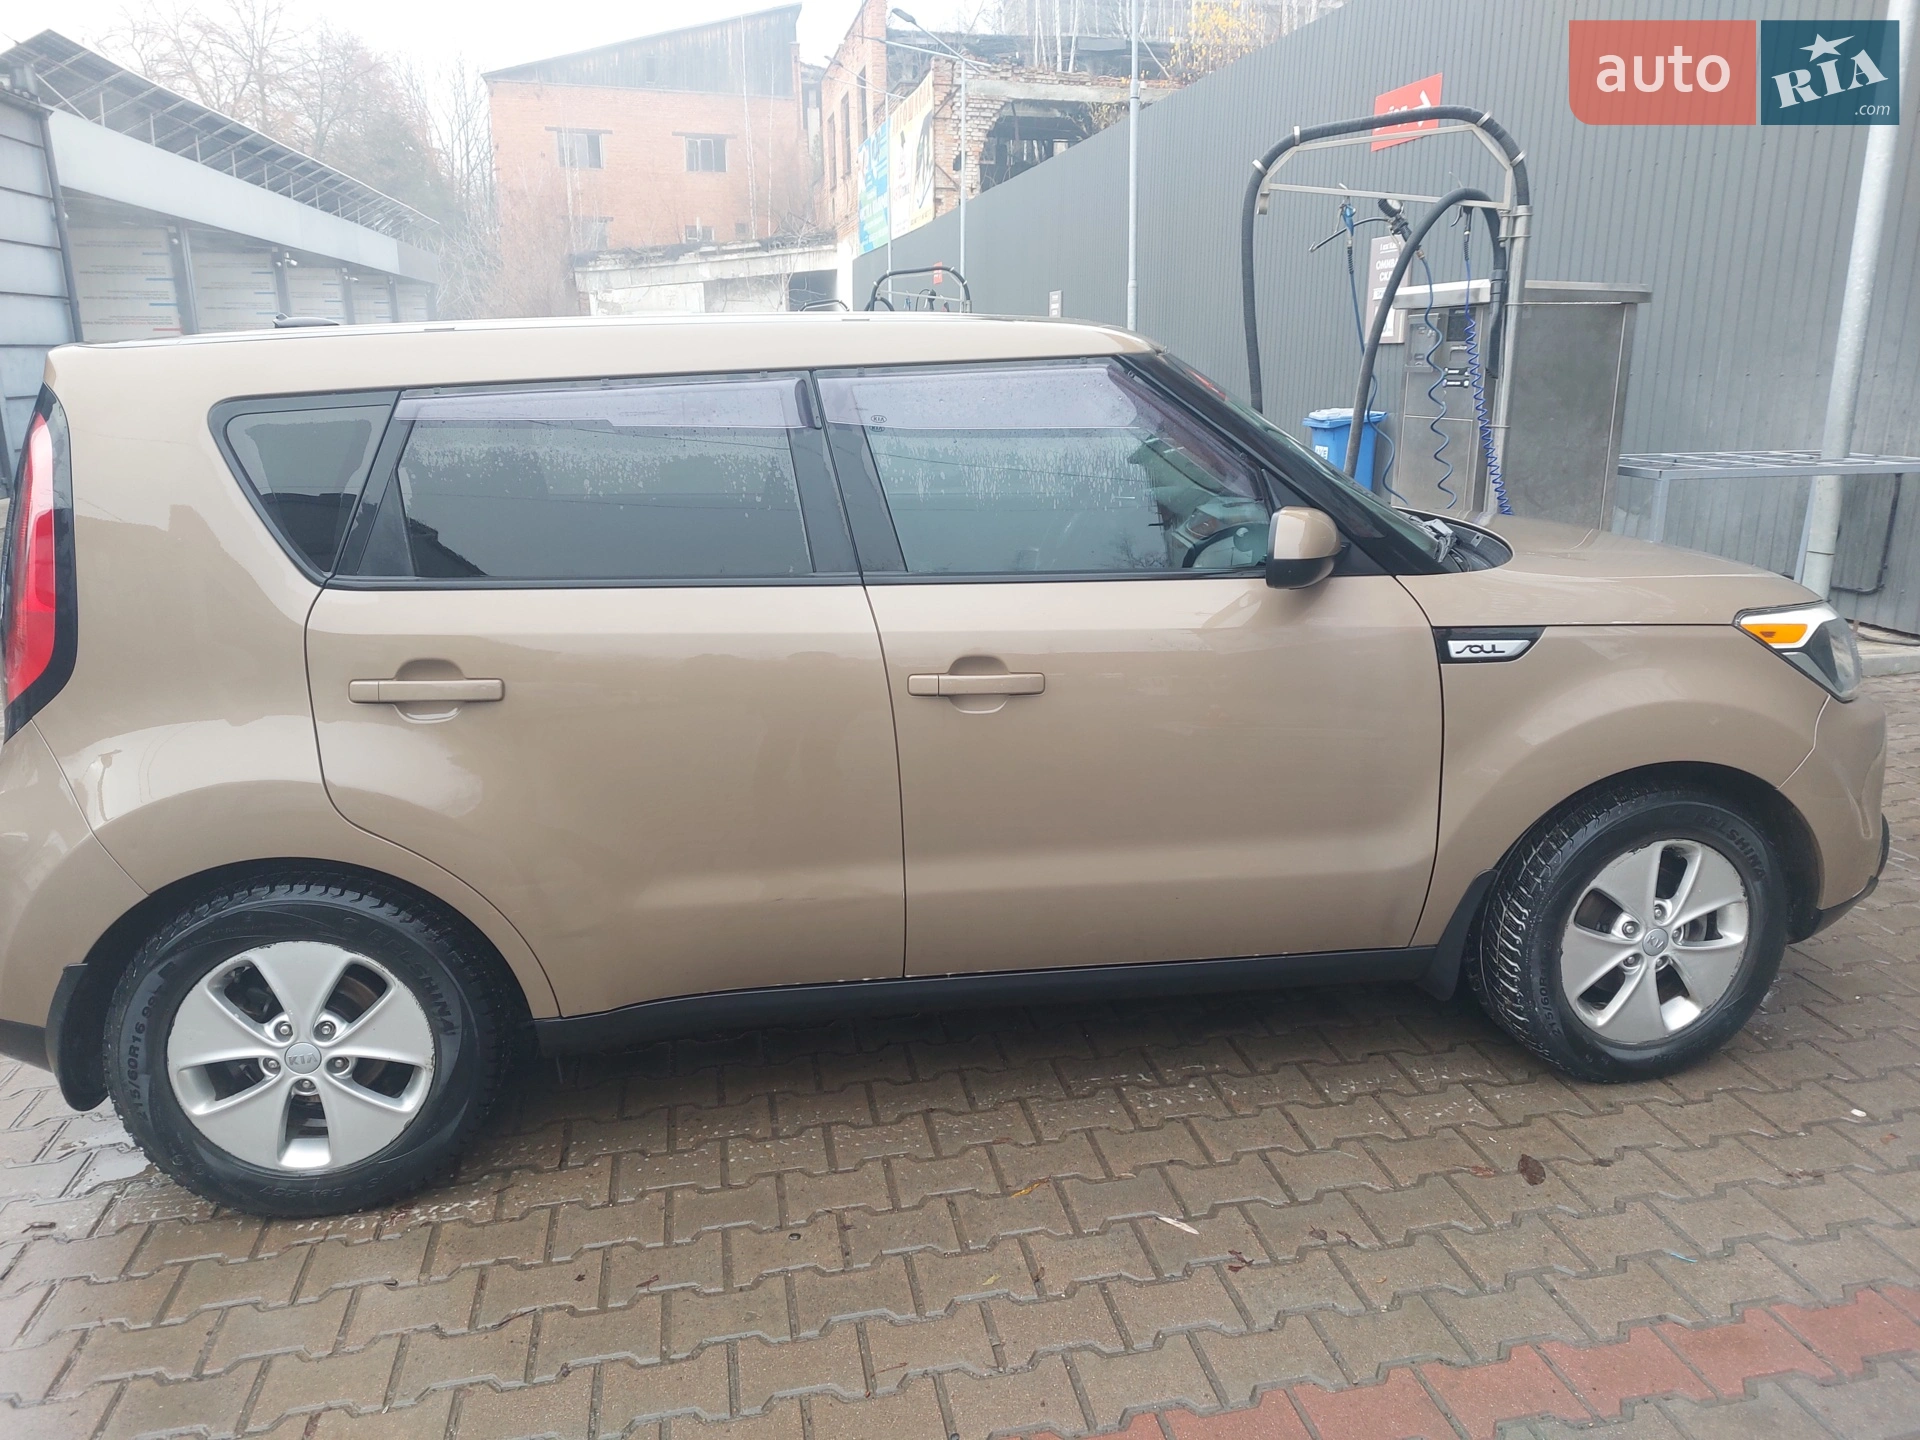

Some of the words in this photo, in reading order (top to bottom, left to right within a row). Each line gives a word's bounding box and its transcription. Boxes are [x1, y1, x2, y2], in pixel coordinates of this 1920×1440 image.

[1455, 644, 1506, 654] SOUL
[1646, 934, 1665, 949] KIA
[287, 1052, 319, 1066] KIA
